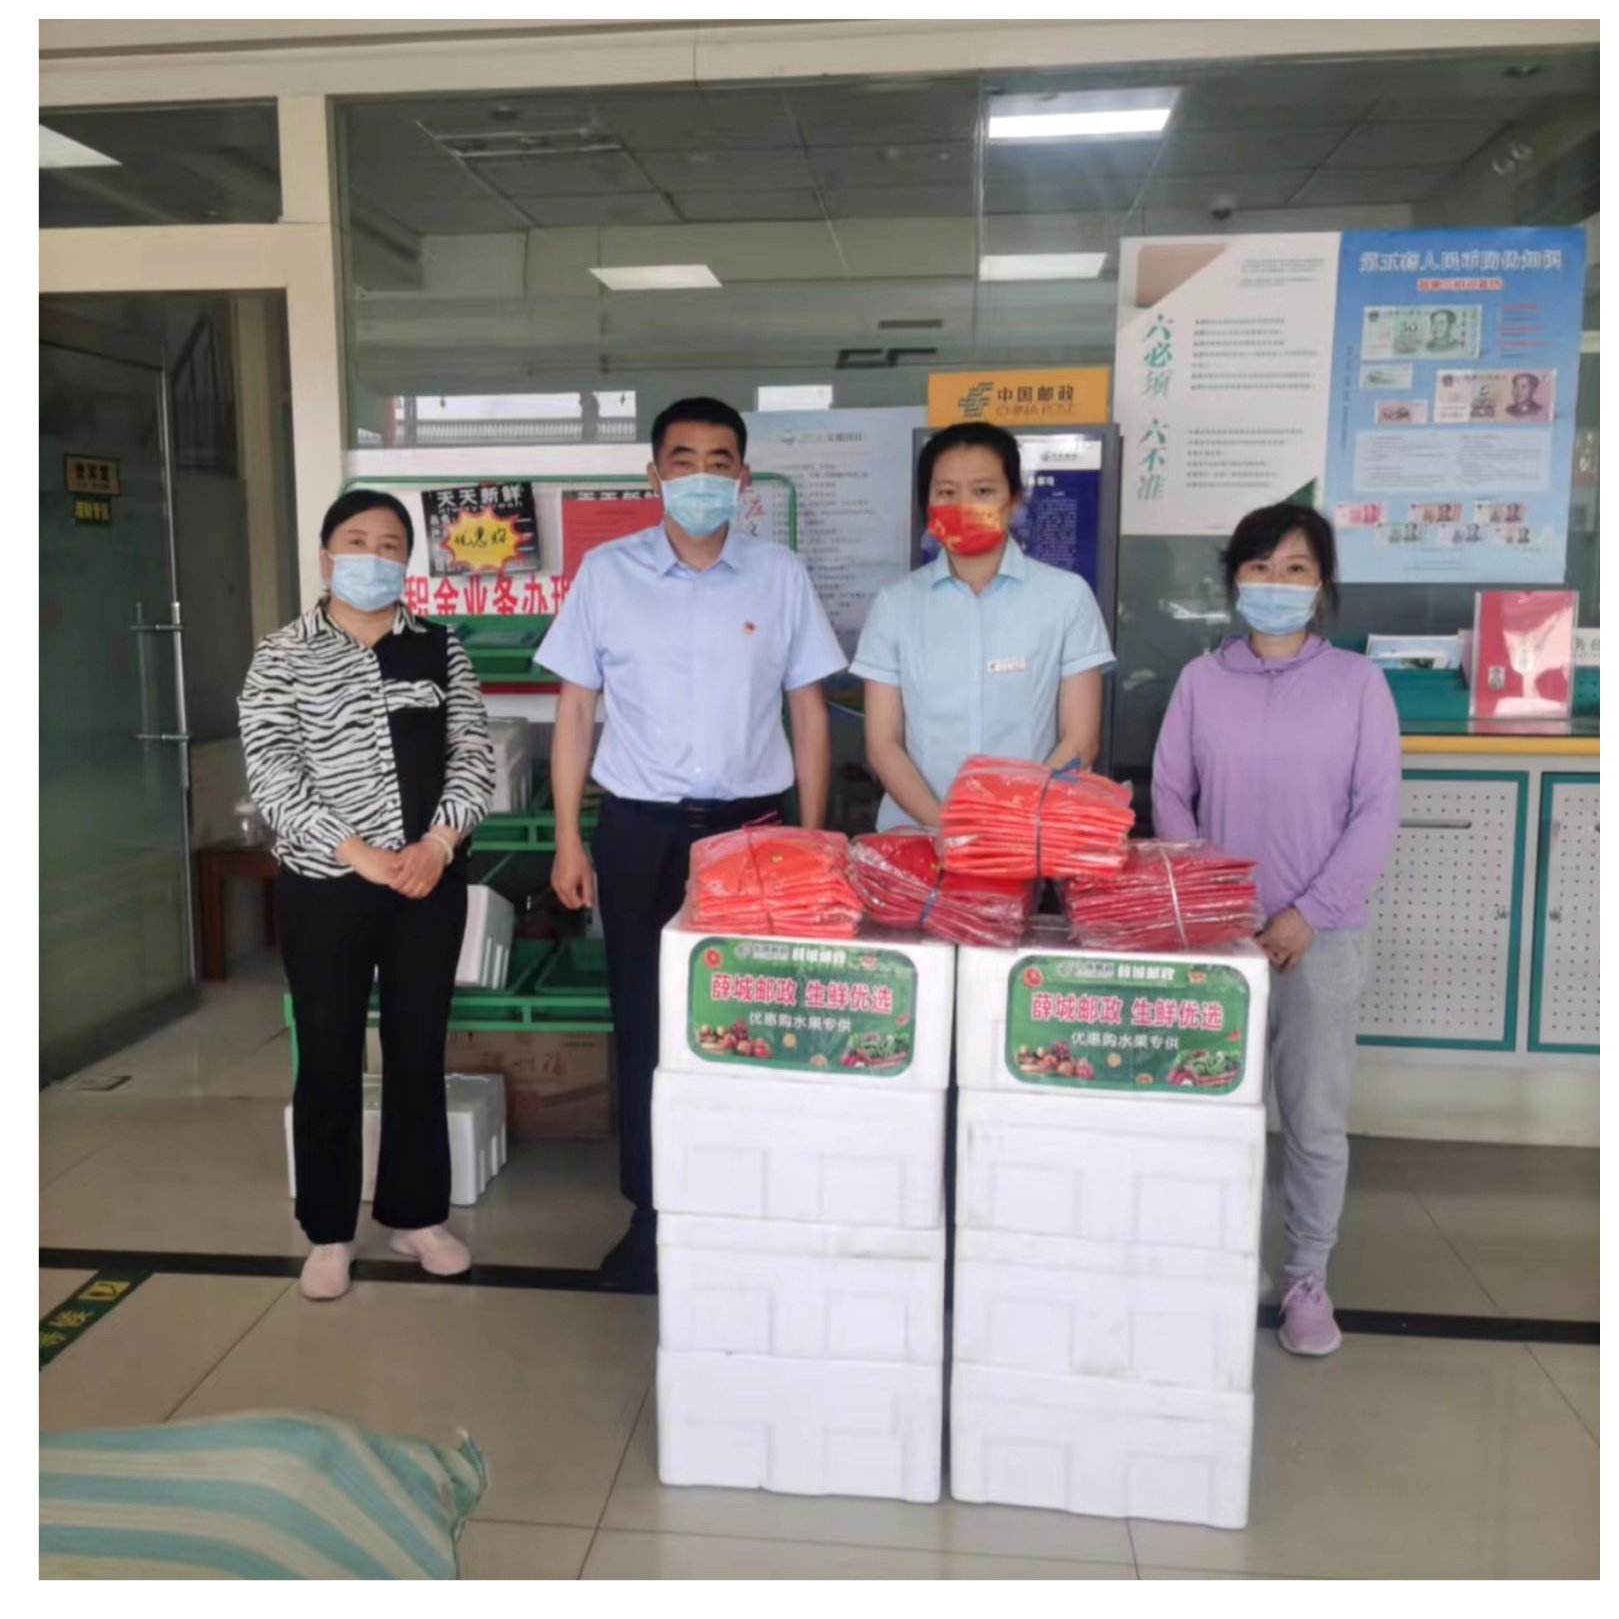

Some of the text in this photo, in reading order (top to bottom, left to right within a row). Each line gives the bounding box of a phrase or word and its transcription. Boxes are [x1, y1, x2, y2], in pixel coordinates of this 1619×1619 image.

[997, 385, 1074, 403] 中国邮政
[436, 484, 522, 507] 天天新鲜
[711, 971, 893, 1014] 薛城邮政 生鲜优选
[749, 1011, 852, 1032] 优惠购水果专供
[1031, 992, 1224, 1031] 薛城邮政 生鲜优选
[1071, 1031, 1180, 1050] 优惠购水果专供
